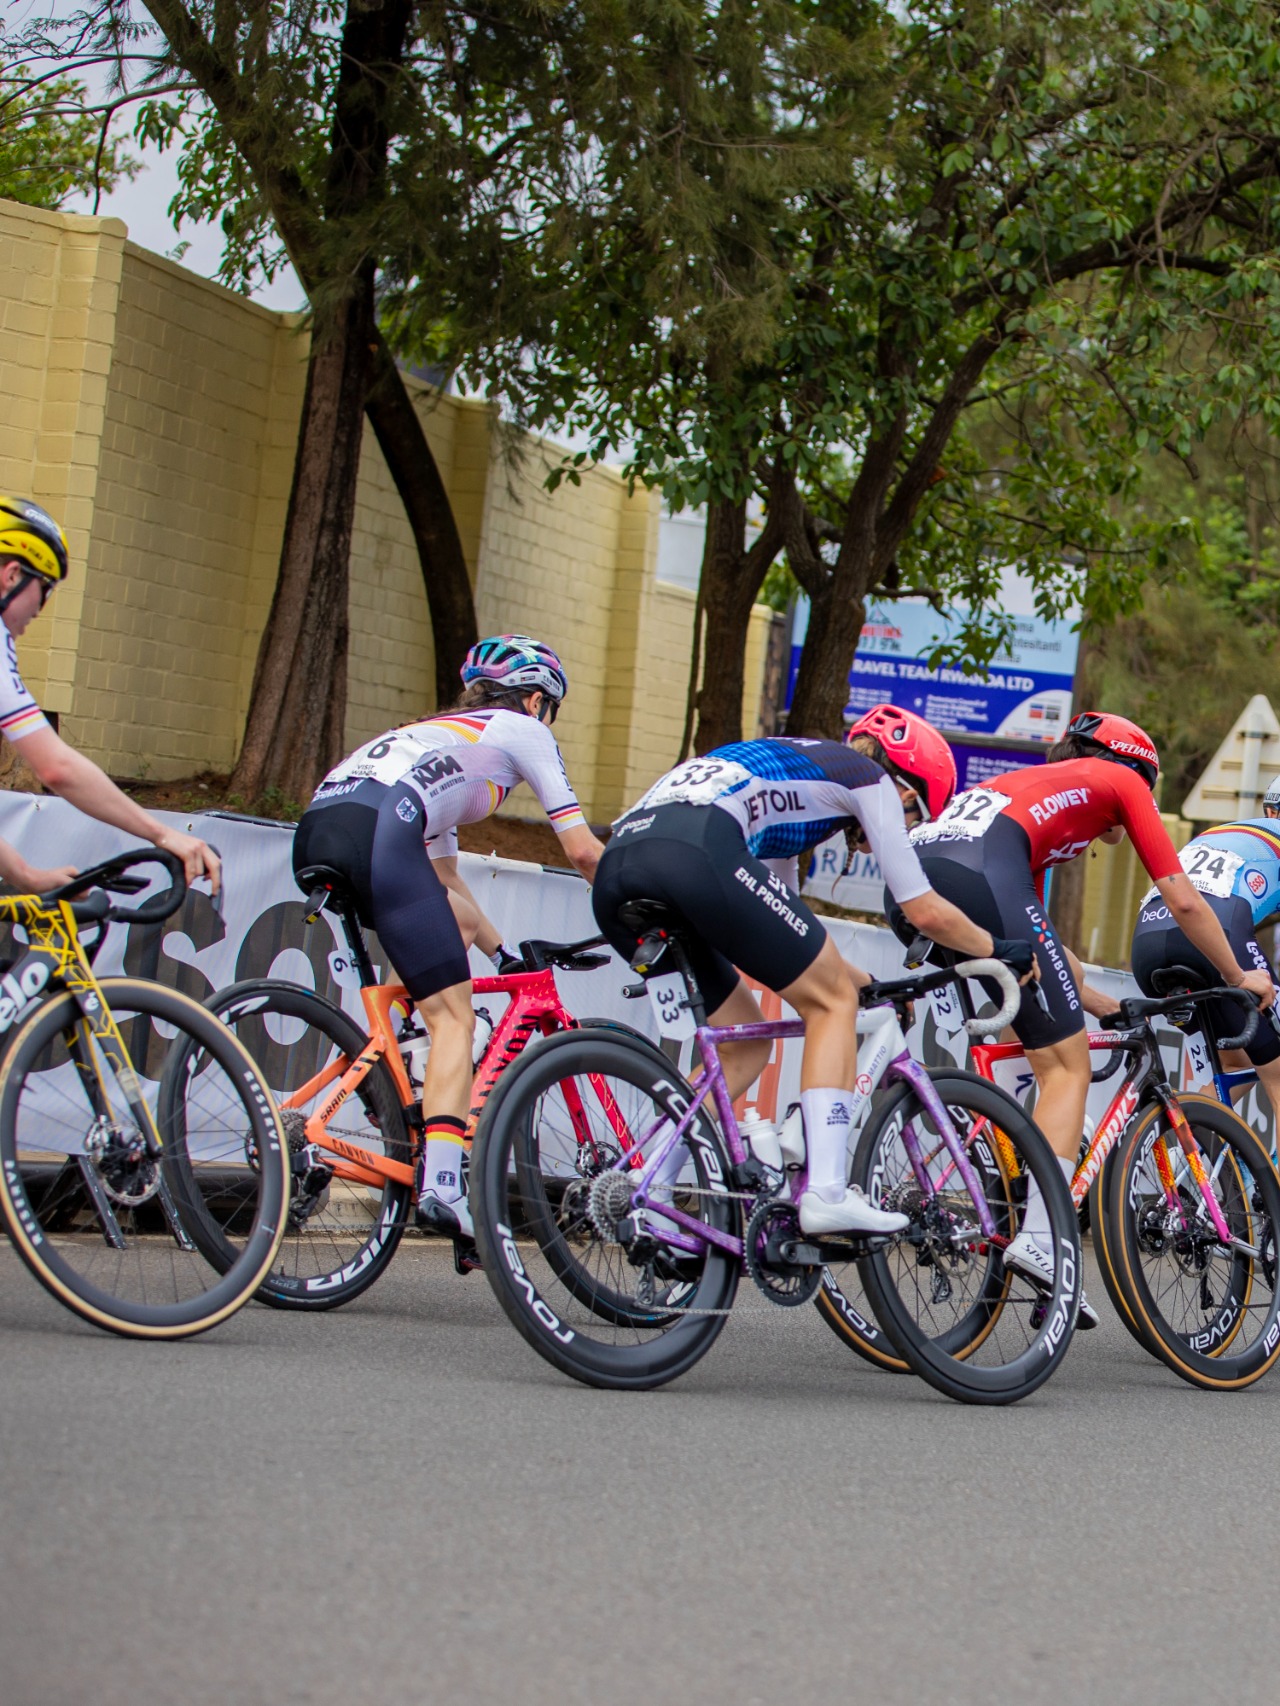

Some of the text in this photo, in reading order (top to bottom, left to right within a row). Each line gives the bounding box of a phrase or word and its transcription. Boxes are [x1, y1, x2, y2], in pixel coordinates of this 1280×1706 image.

[898, 663, 939, 682] TEAM
[1006, 679, 1034, 692] LTD
[367, 736, 397, 760] 6
[351, 769, 377, 777] WANDA
[356, 763, 376, 771] VISIT
[411, 754, 464, 791] KTM
[670, 764, 725, 788] 33
[948, 793, 993, 823] 32
[1028, 788, 1089, 826] FLOWEY
[1188, 850, 1227, 880] 24
[734, 866, 756, 893] EHL
[756, 884, 810, 938] PROFILES
[333, 957, 348, 973] 6
[657, 988, 681, 1024] 33
[1089, 1033, 1130, 1043] SPECIALIZED
[1190, 1046, 1205, 1073] 24
[243, 1070, 281, 1152] RESERVE
[319, 1088, 348, 1124] SRAM
[331, 1138, 376, 1167] CANYON
[870, 1110, 904, 1211] oval
[1129, 1120, 1161, 1211] roval
[496, 1222, 576, 1346] roval
[1045, 1236, 1077, 1358] roval
[822, 1265, 879, 1341] rova
